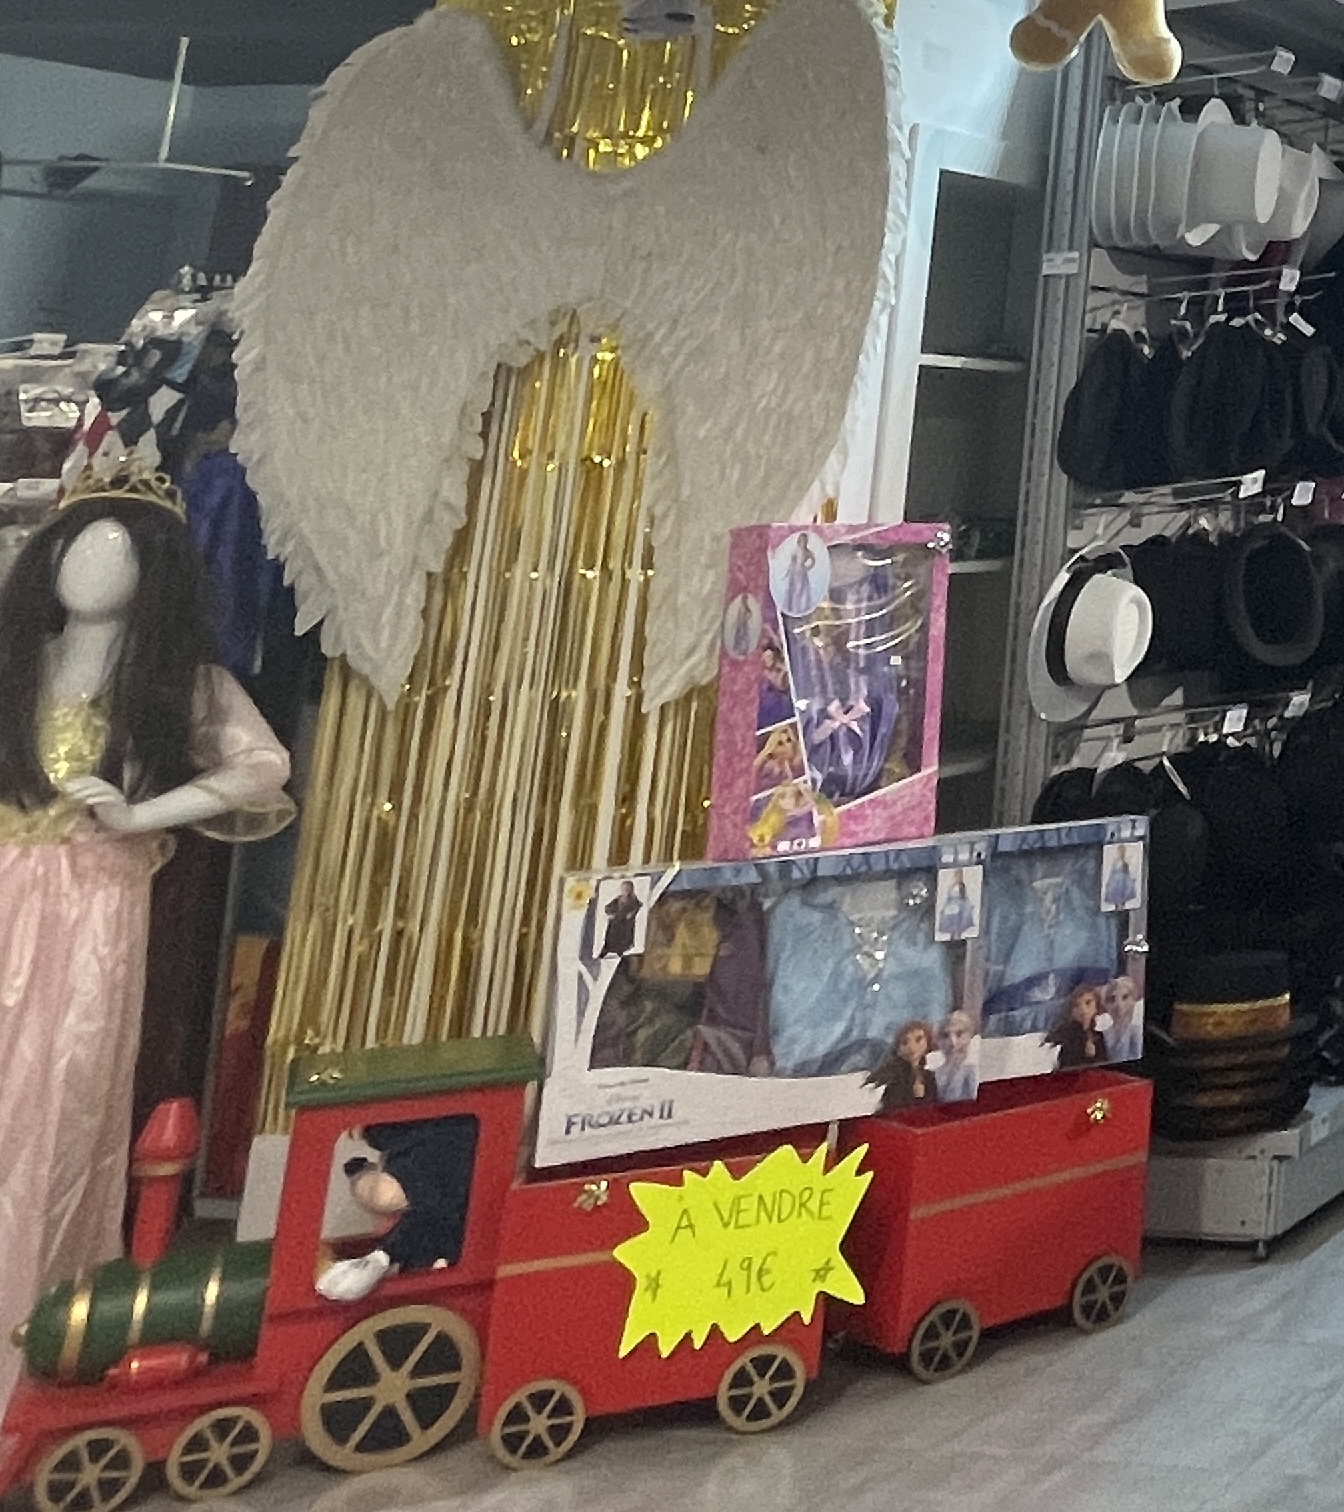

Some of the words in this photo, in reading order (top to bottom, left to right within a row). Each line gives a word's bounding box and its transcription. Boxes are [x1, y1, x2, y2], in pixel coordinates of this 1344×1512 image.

[564, 1105, 653, 1135] FROZEN
[712, 1186, 834, 1230] VENDRE
[712, 1250, 778, 1300] 49€
